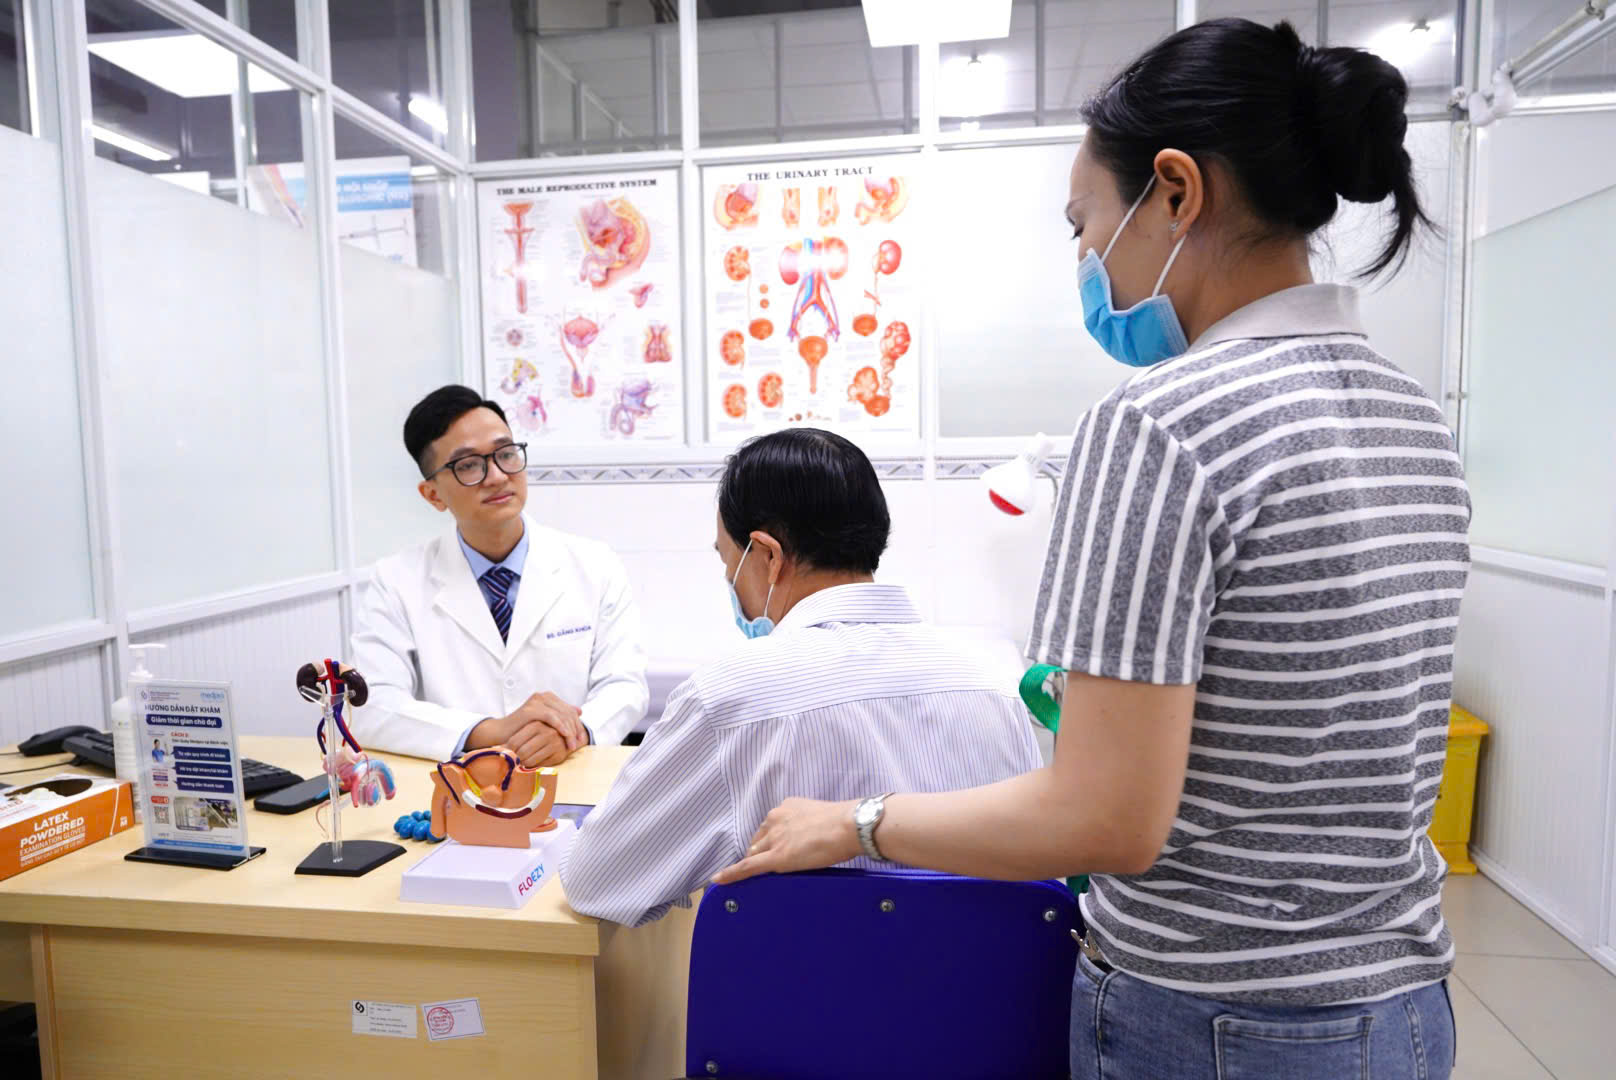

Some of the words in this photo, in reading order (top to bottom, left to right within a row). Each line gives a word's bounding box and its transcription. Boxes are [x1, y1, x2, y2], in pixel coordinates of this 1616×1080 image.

[747, 172, 770, 181] THE
[776, 169, 828, 180] URINARY
[834, 166, 873, 176] TRACT
[496, 187, 515, 196] THE
[518, 185, 543, 194] MALE
[546, 181, 616, 192] REPRODUCTIVE
[619, 178, 657, 188] SYSTEM
[20, 816, 85, 848] POWDERED
[34, 811, 69, 832] LATEX
[20, 834, 63, 857] EXAMINATION
[518, 863, 544, 896] FLOEZY
